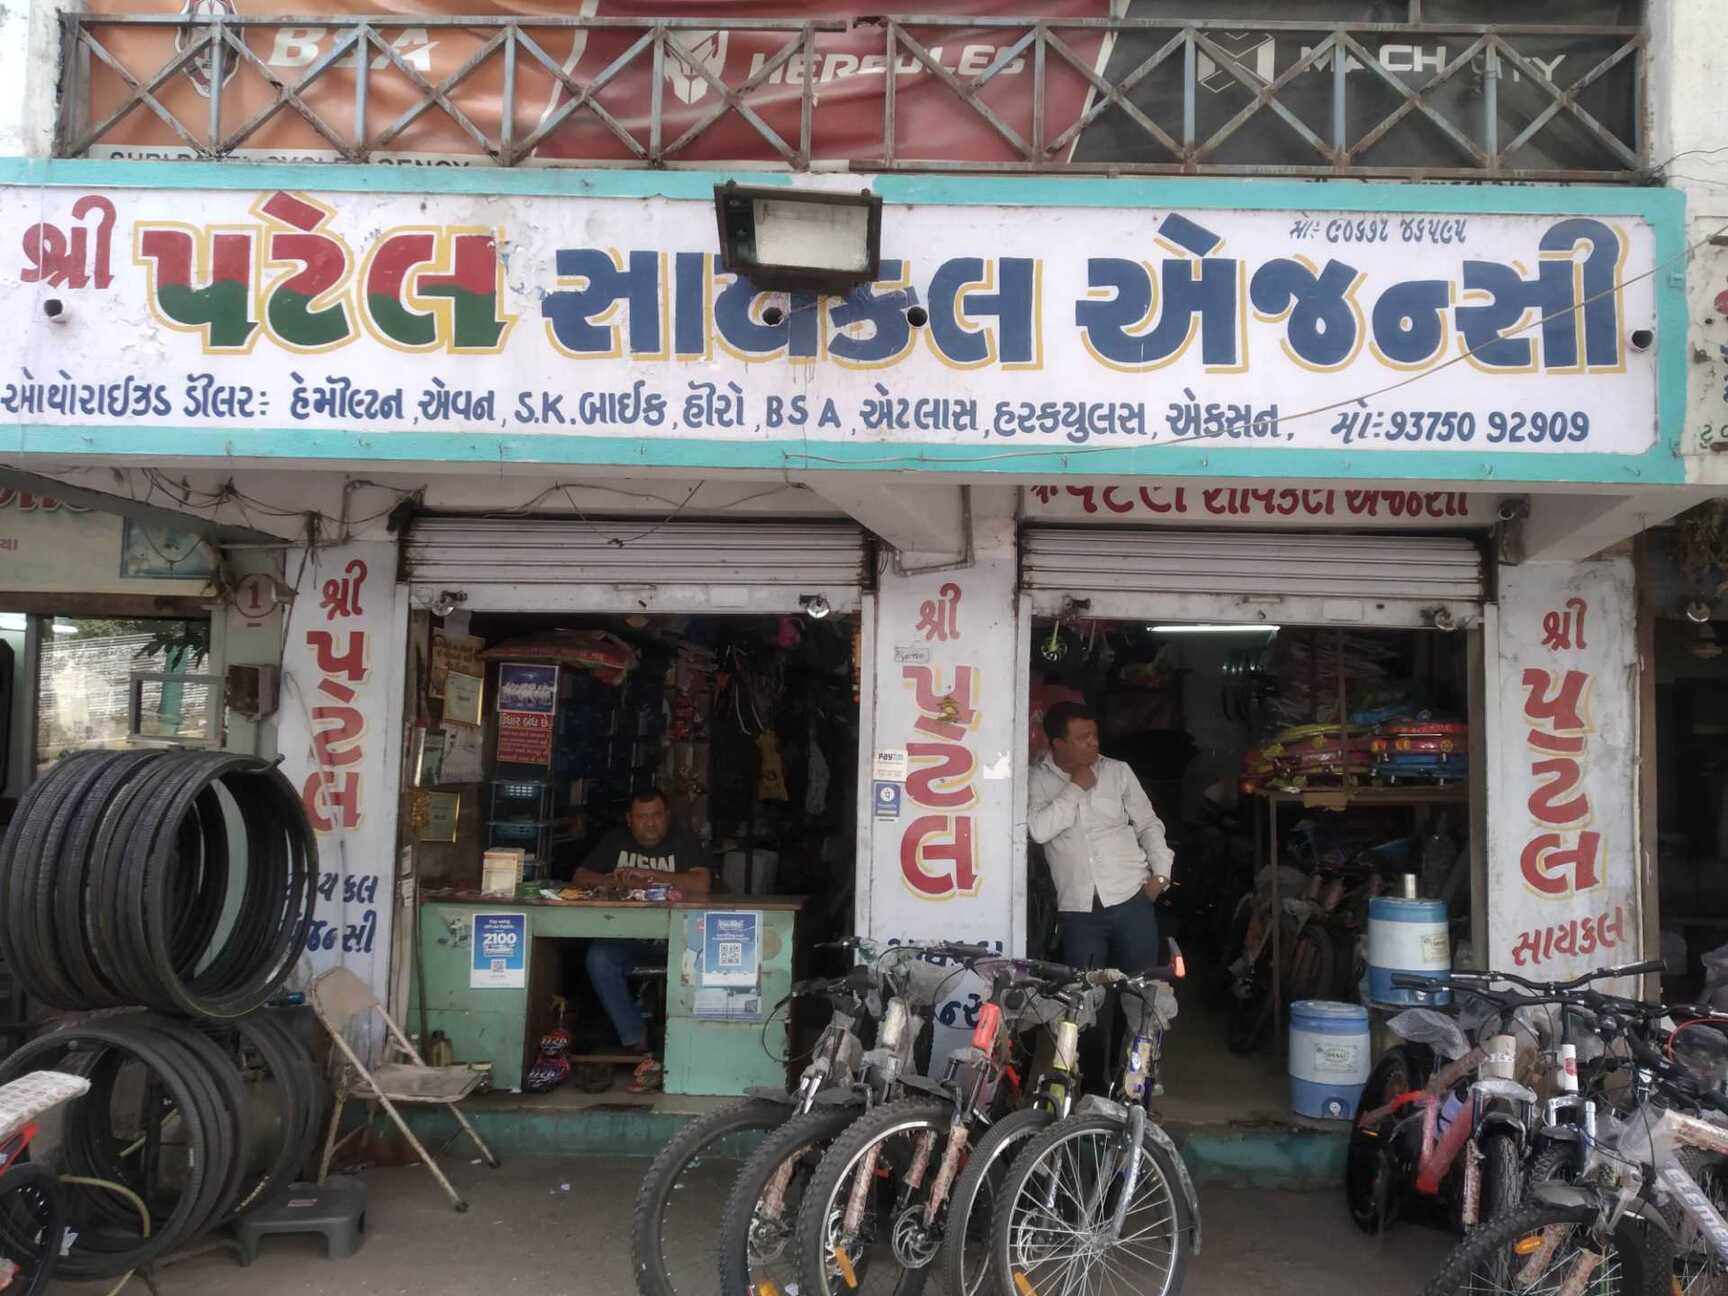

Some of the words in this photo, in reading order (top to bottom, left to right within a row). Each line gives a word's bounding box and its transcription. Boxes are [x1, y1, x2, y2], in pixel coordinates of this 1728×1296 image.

[20, 195, 117, 289] શ્રી
[136, 189, 518, 355] પટેલ
[1075, 212, 1628, 374] એજન્સી
[1486, 411, 1590, 443] 92909
[320, 559, 368, 620] શ્રી
[915, 582, 963, 641] શ્રી
[1541, 597, 1588, 650] શ્રી
[483, 933, 517, 945] 2100
[1512, 906, 1626, 967] સાયકલ
